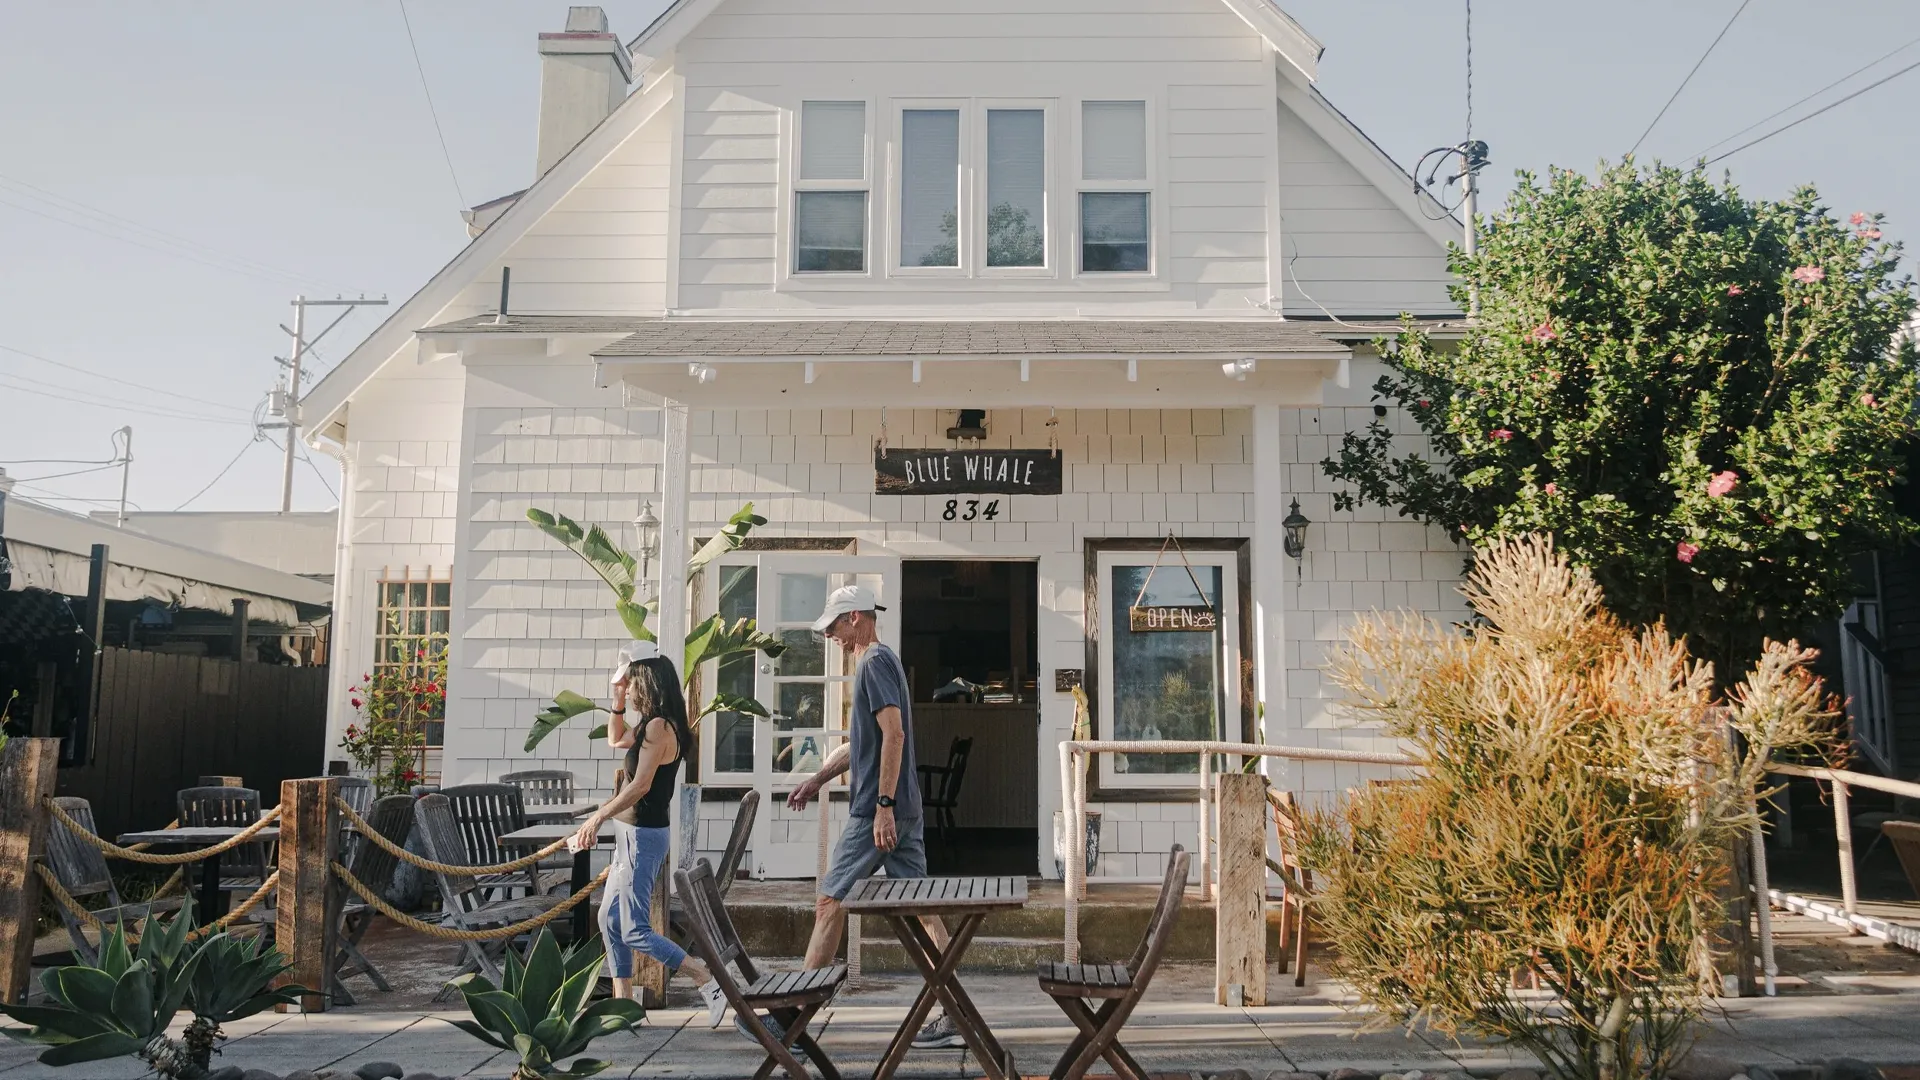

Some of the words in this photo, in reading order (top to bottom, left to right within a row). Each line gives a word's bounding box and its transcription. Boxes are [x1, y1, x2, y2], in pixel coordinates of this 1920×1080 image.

[905, 456, 951, 484] BLUE
[964, 455, 1034, 485] WHALE
[942, 499, 999, 521] 834
[1147, 607, 1193, 628] OPEN
[799, 736, 819, 756] A
